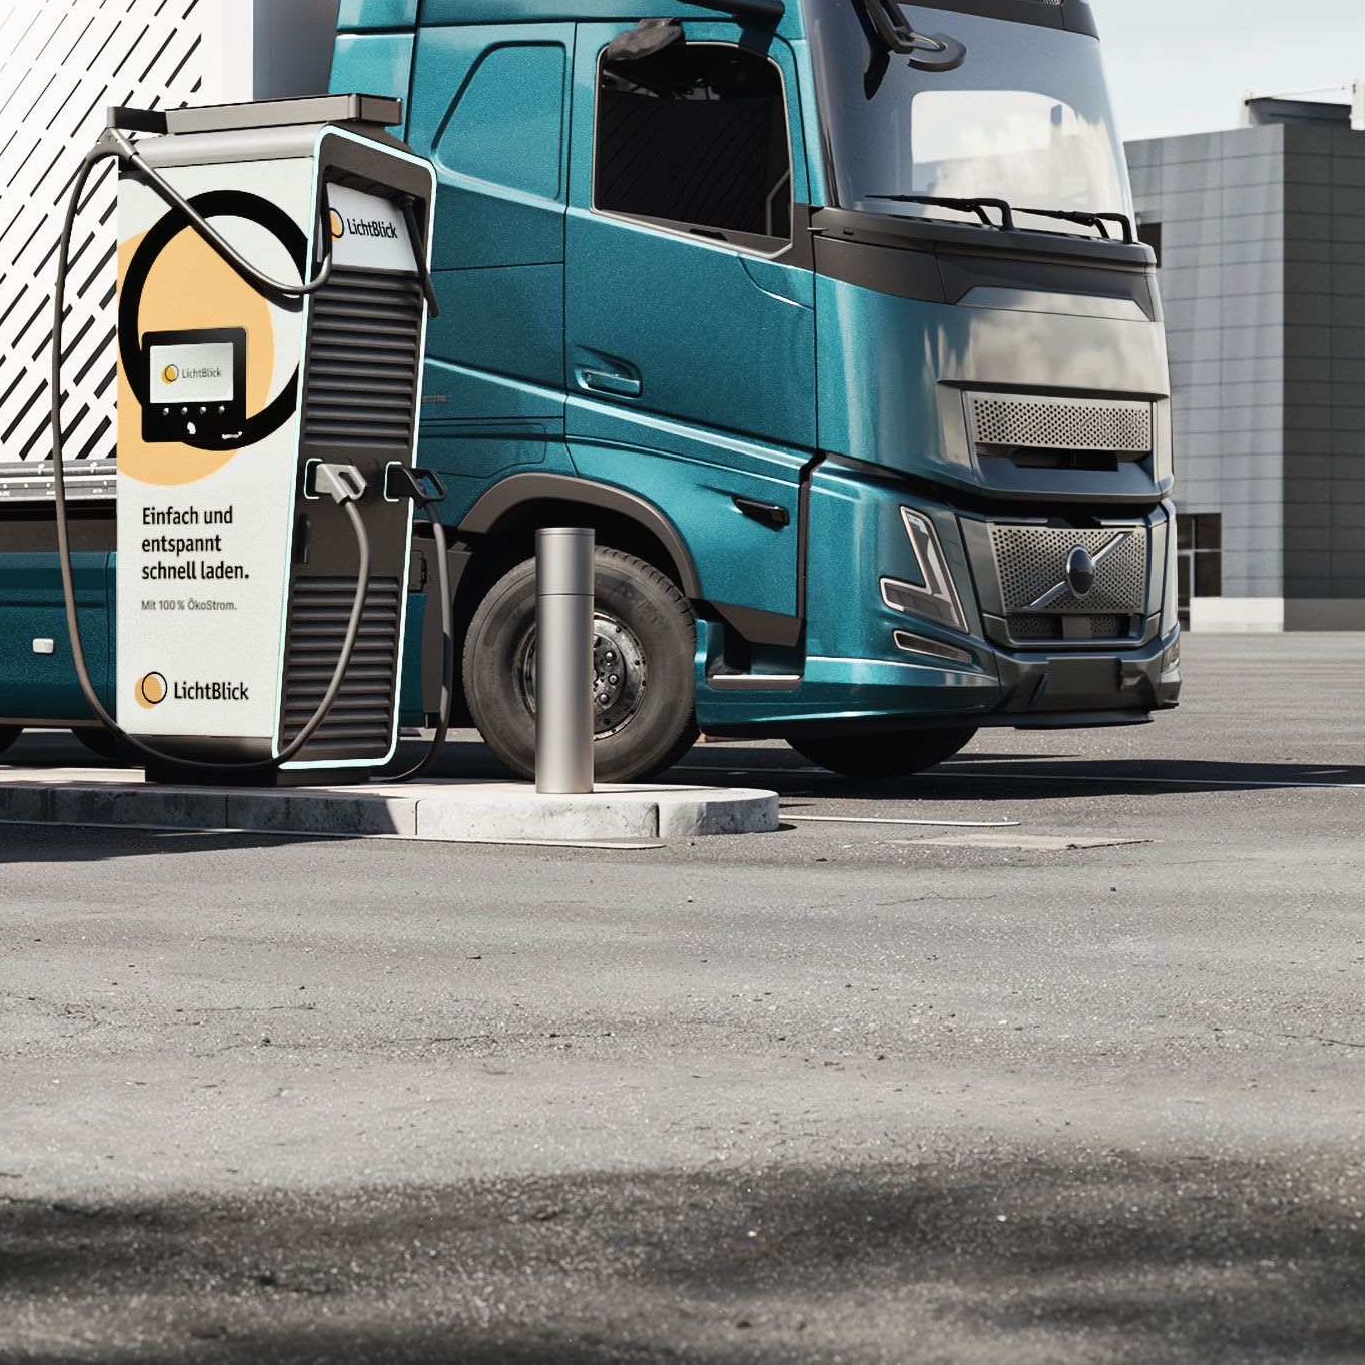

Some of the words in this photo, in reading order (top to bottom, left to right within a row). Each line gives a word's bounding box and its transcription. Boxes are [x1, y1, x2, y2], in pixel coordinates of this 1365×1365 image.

[346, 217, 399, 240] LichtBlick
[142, 505, 199, 525] Einfach
[203, 505, 233, 525] und
[141, 534, 222, 557] entspannt
[141, 560, 197, 580] schnell
[201, 560, 250, 580] laden.
[141, 600, 157, 611] Mit
[173, 681, 249, 701] LichtBlick
